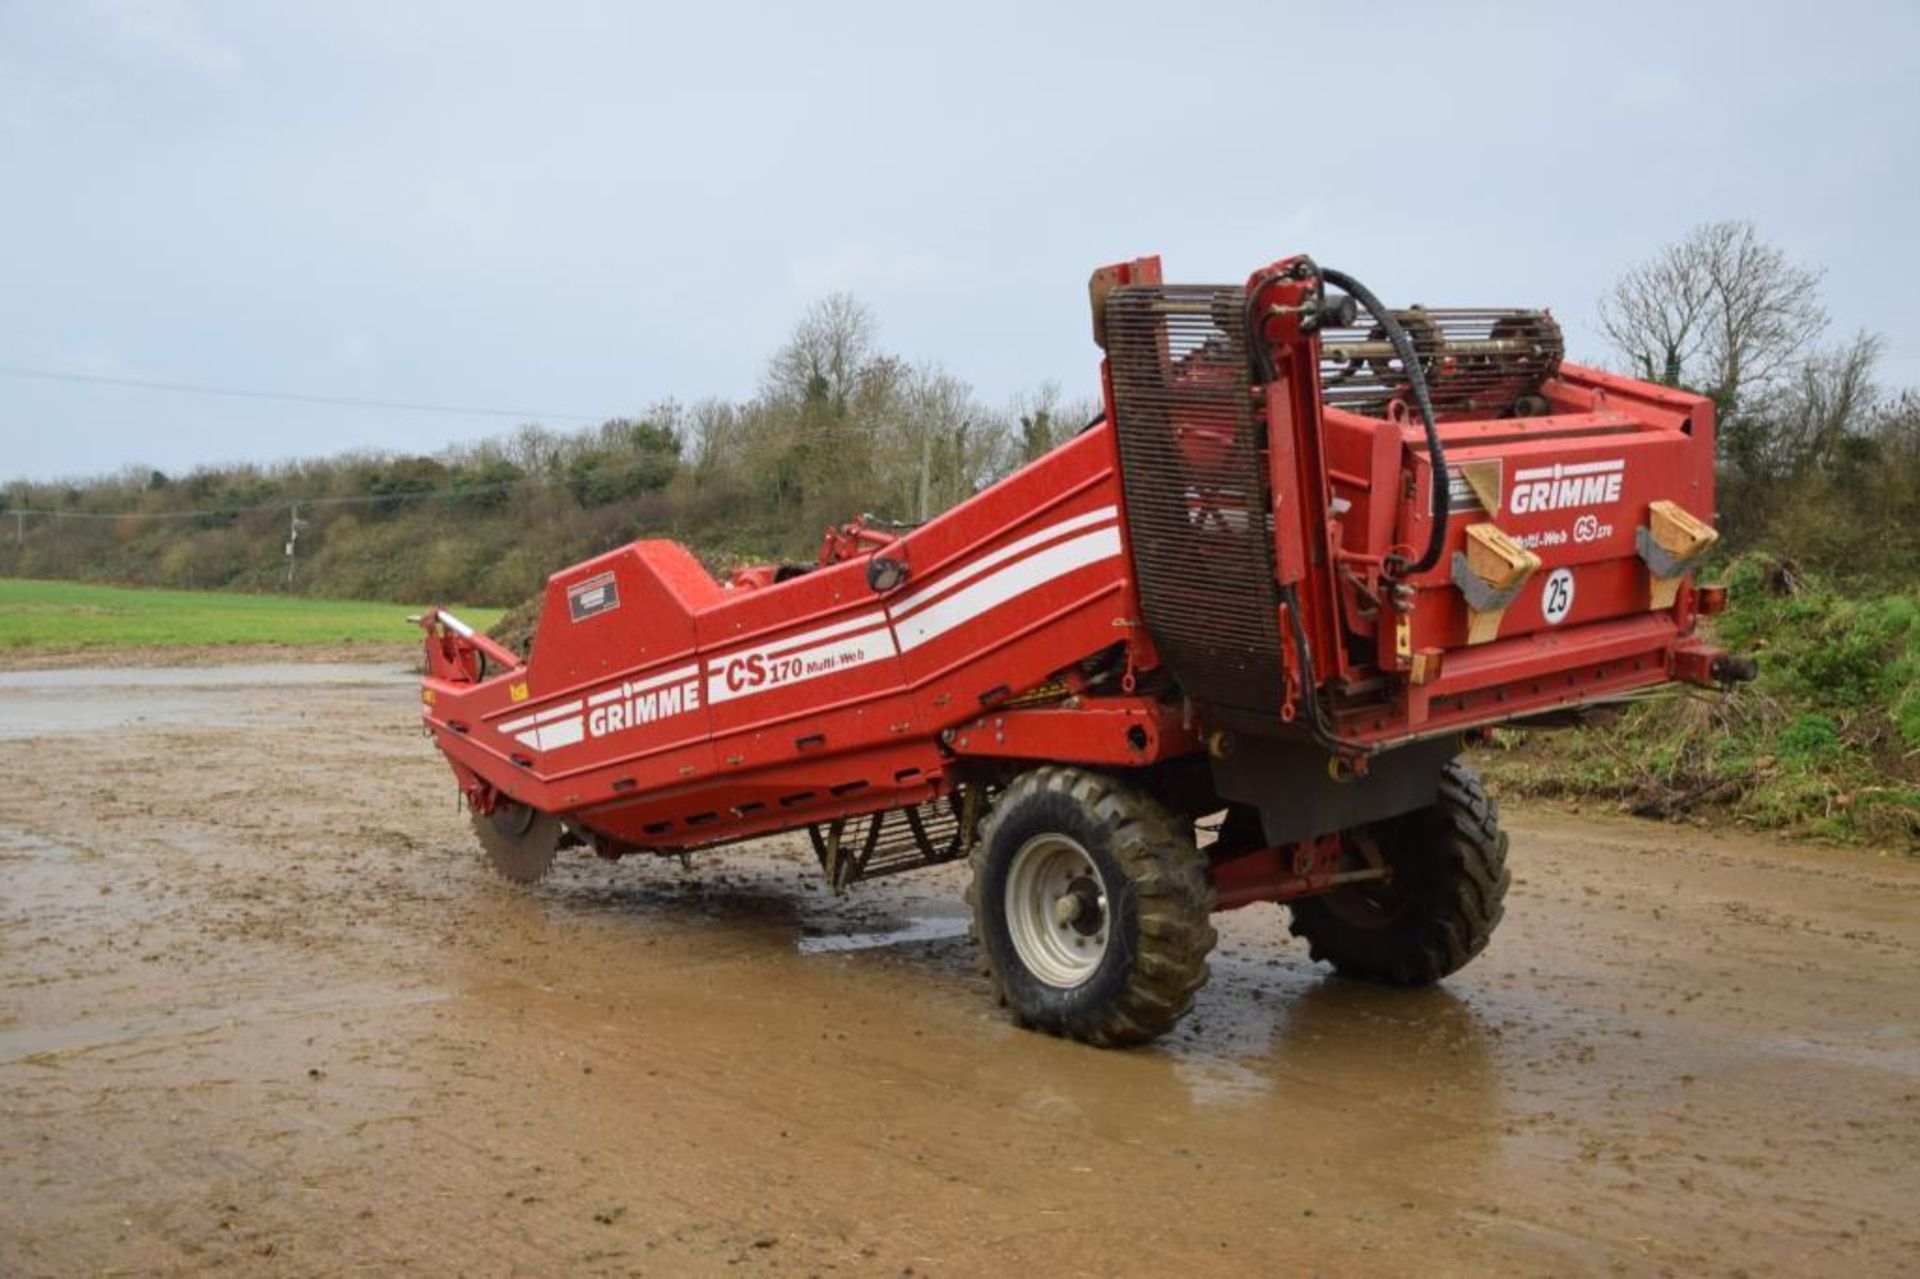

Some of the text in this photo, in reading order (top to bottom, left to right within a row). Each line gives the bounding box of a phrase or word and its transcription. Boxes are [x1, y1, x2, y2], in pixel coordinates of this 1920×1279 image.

[1510, 463, 1624, 515] GRIMME
[1547, 577, 1569, 614] 25
[588, 680, 700, 739] GRIMME
